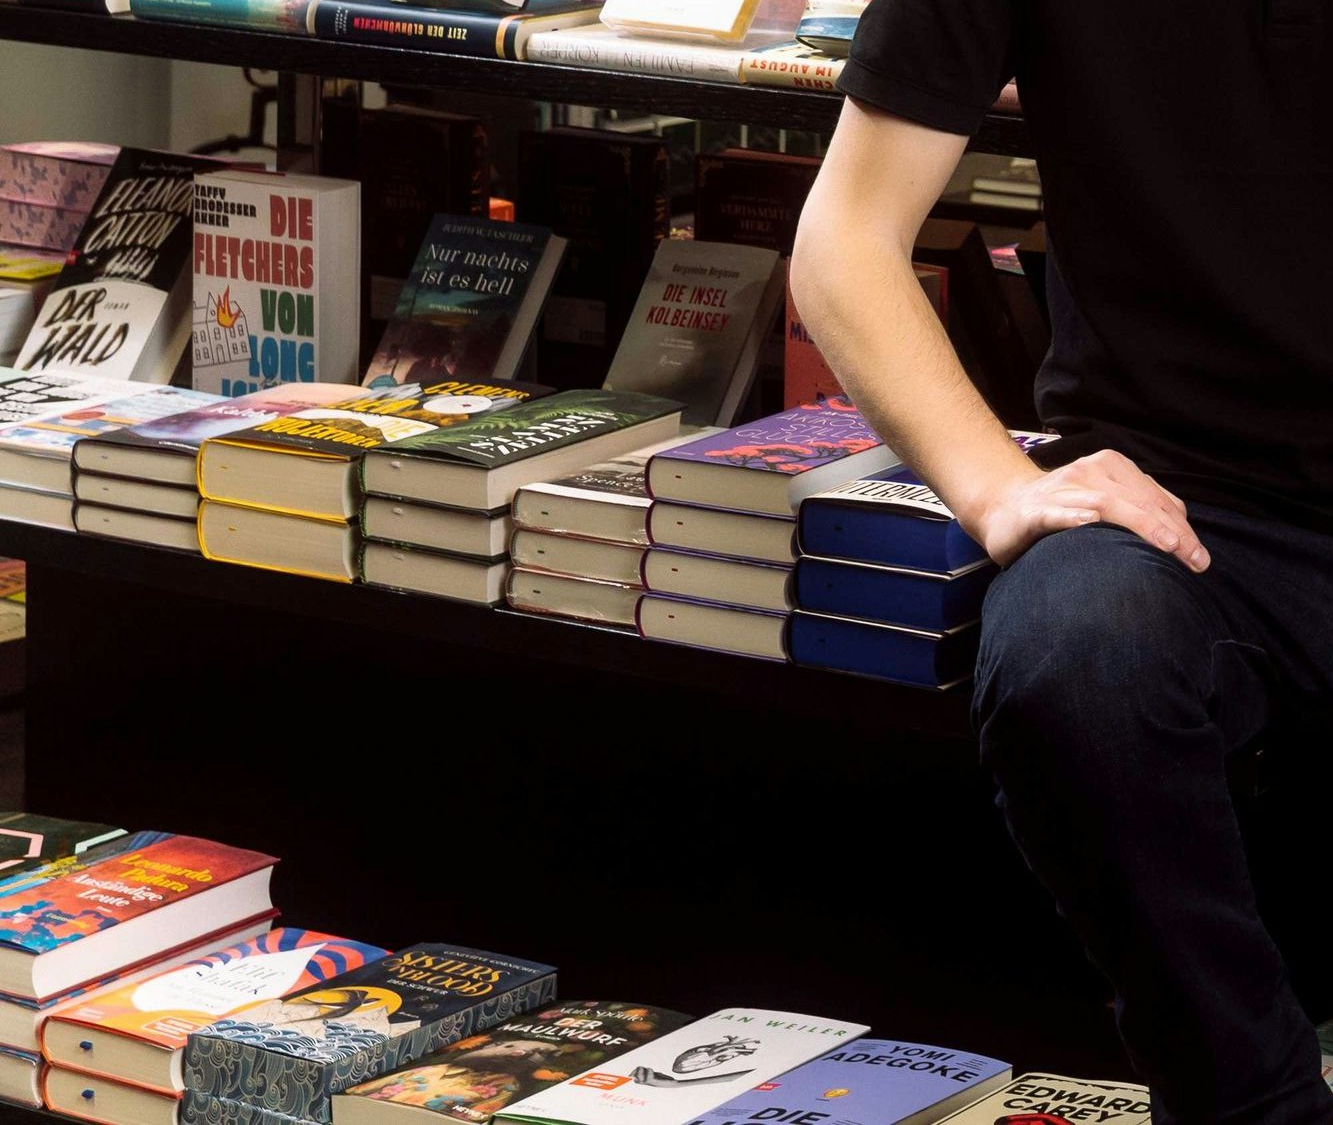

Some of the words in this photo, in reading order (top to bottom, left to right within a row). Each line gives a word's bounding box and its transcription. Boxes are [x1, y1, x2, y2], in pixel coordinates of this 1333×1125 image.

[427, 24, 445, 38] DER
[447, 27, 468, 41] ZEIT
[750, 59, 809, 75] AUGUST
[815, 66, 833, 77] IM
[793, 76, 834, 90] CHEN
[97, 176, 194, 220] ELEANOR
[194, 183, 226, 201] TAFFY
[194, 198, 257, 218] BRODESSER
[269, 193, 313, 242] DIE
[83, 212, 183, 255] CATTON
[194, 231, 314, 290] FLETCHERS
[425, 242, 461, 266] Nur
[464, 246, 529, 274] nachts
[420, 266, 445, 288] ist
[449, 273, 469, 290] es
[474, 270, 513, 297] hell
[662, 282, 688, 304] DIE
[688, 285, 728, 309] INSEL
[45, 288, 107, 328] DER
[260, 289, 314, 338] VON
[645, 304, 730, 333] KOLBEINSEY
[22, 322, 130, 372] WALD
[249, 334, 315, 383] LONG
[423, 381, 530, 401] CLEMENS
[254, 415, 381, 449] PROJEKTOREN
[119, 853, 213, 884] Leonardo
[121, 868, 191, 894] Padura
[70, 872, 164, 903] Anständige
[78, 886, 131, 909] Leute
[497, 1023, 629, 1047] MAULWURF
[553, 1017, 604, 1030] DER
[709, 1013, 755, 1024] JAN
[765, 1020, 849, 1038] WEILER
[821, 1050, 980, 1084] ADEGOKE
[888, 1045, 956, 1062] YOMI
[1003, 1095, 1123, 1125] CAREY
[1004, 1082, 1152, 1115] EDWARD
[747, 1106, 832, 1125] DIE
